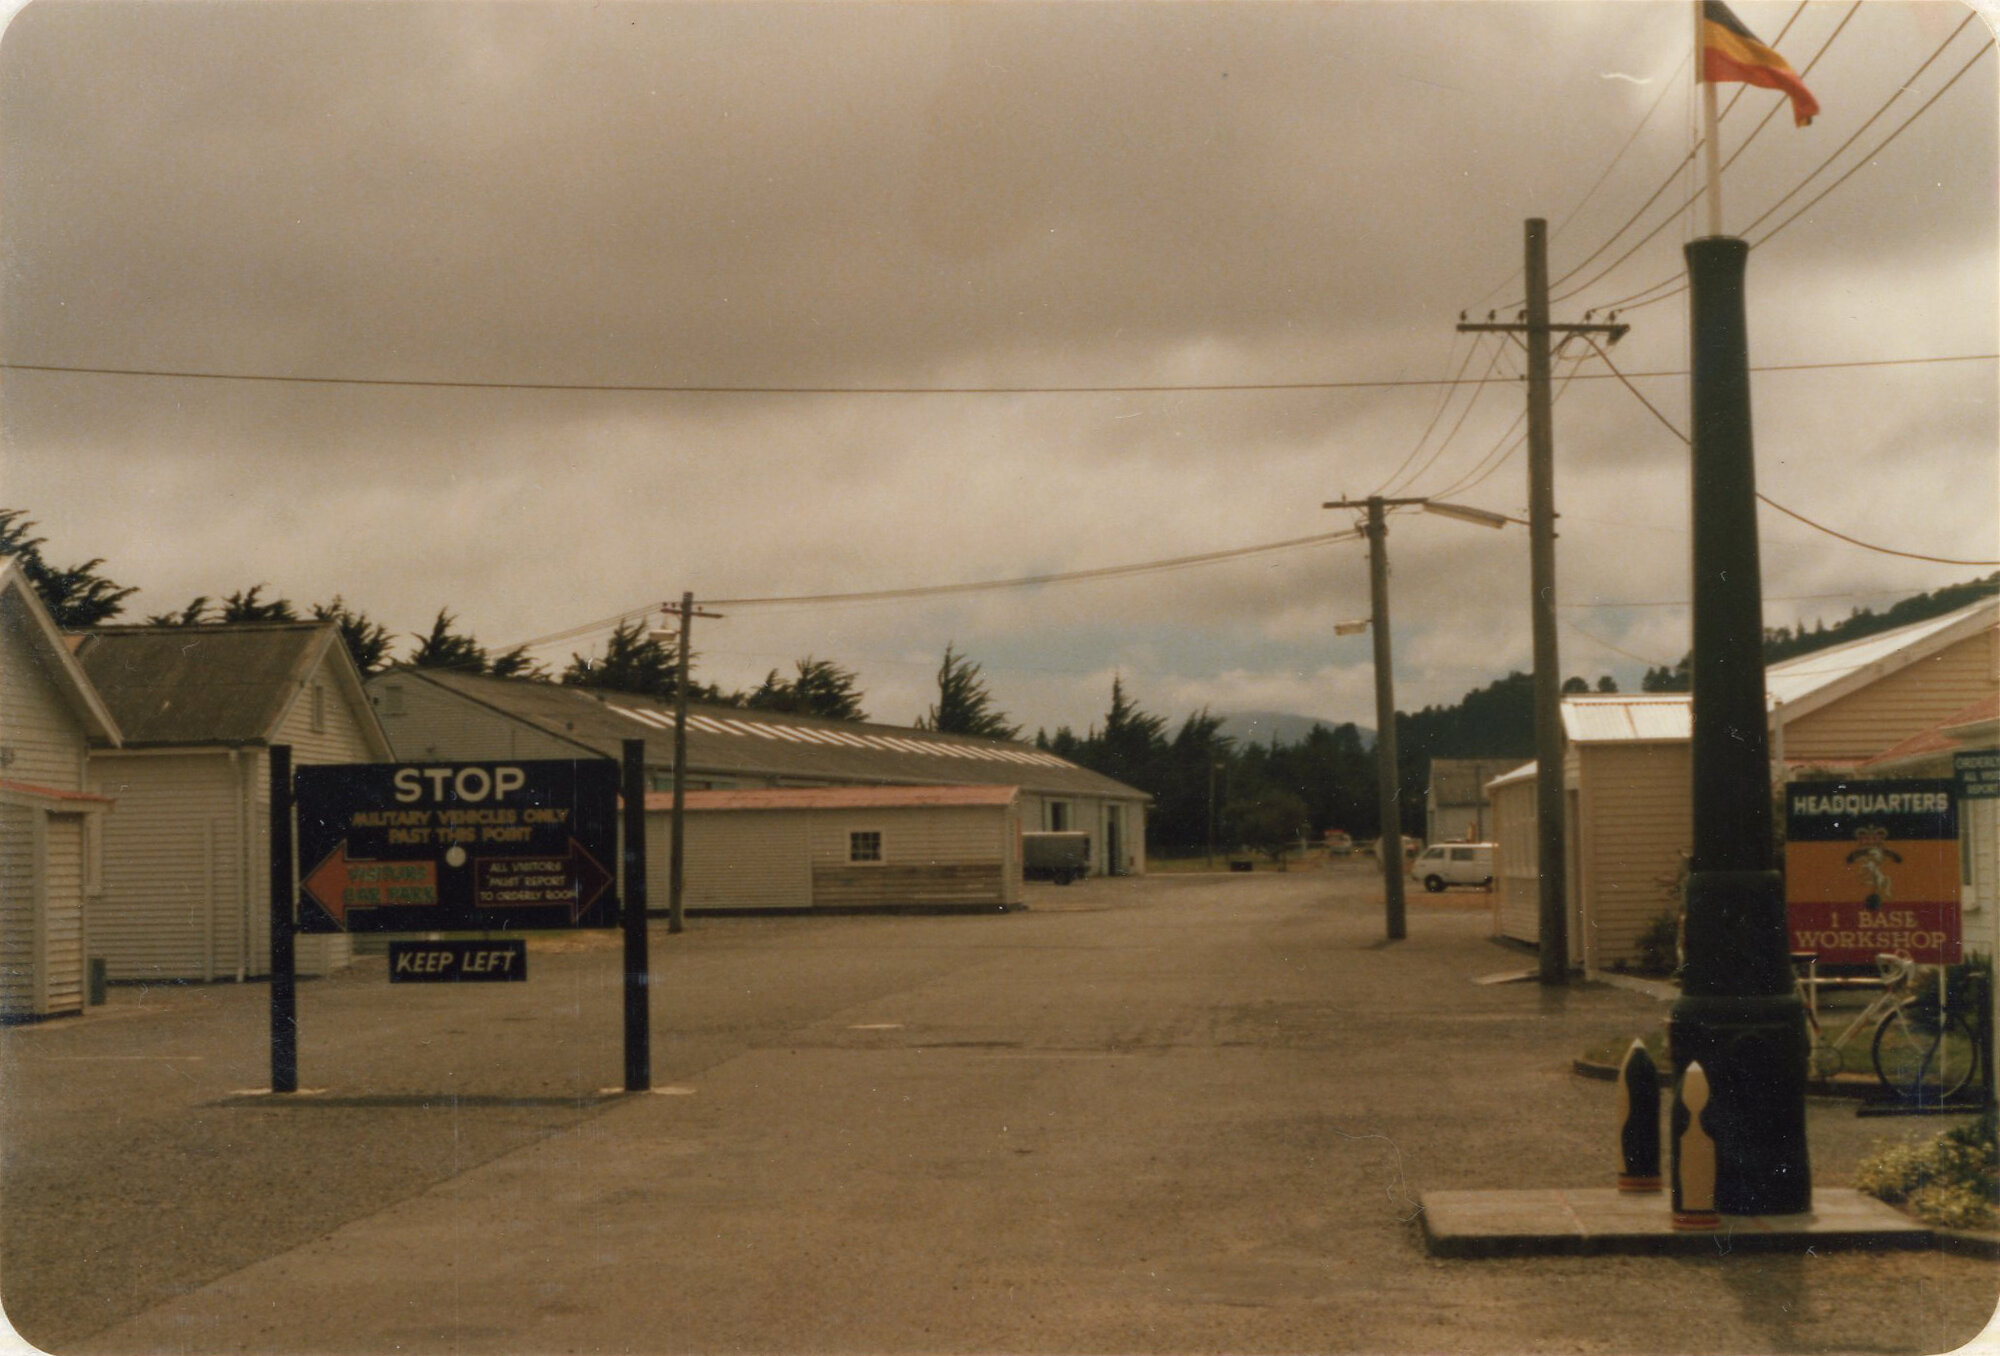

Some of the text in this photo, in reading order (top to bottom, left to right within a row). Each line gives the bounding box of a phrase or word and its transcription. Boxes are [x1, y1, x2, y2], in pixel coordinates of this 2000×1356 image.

[394, 767, 526, 802] STOP
[1793, 792, 1949, 816] HEADQUARTERS
[352, 808, 569, 827] MILITARY VEHICLES ONLY
[388, 826, 533, 844] PAST THIS POINT
[490, 861, 562, 873] ALL VISITORS
[525, 875, 566, 887] REPORT
[480, 890, 494, 900] TO
[496, 890, 542, 901] ORDERLY
[1831, 910, 1919, 929] 1 BASE
[1796, 931, 1948, 950] WORKSHOP
[396, 950, 517, 972] KEEP LEFT
